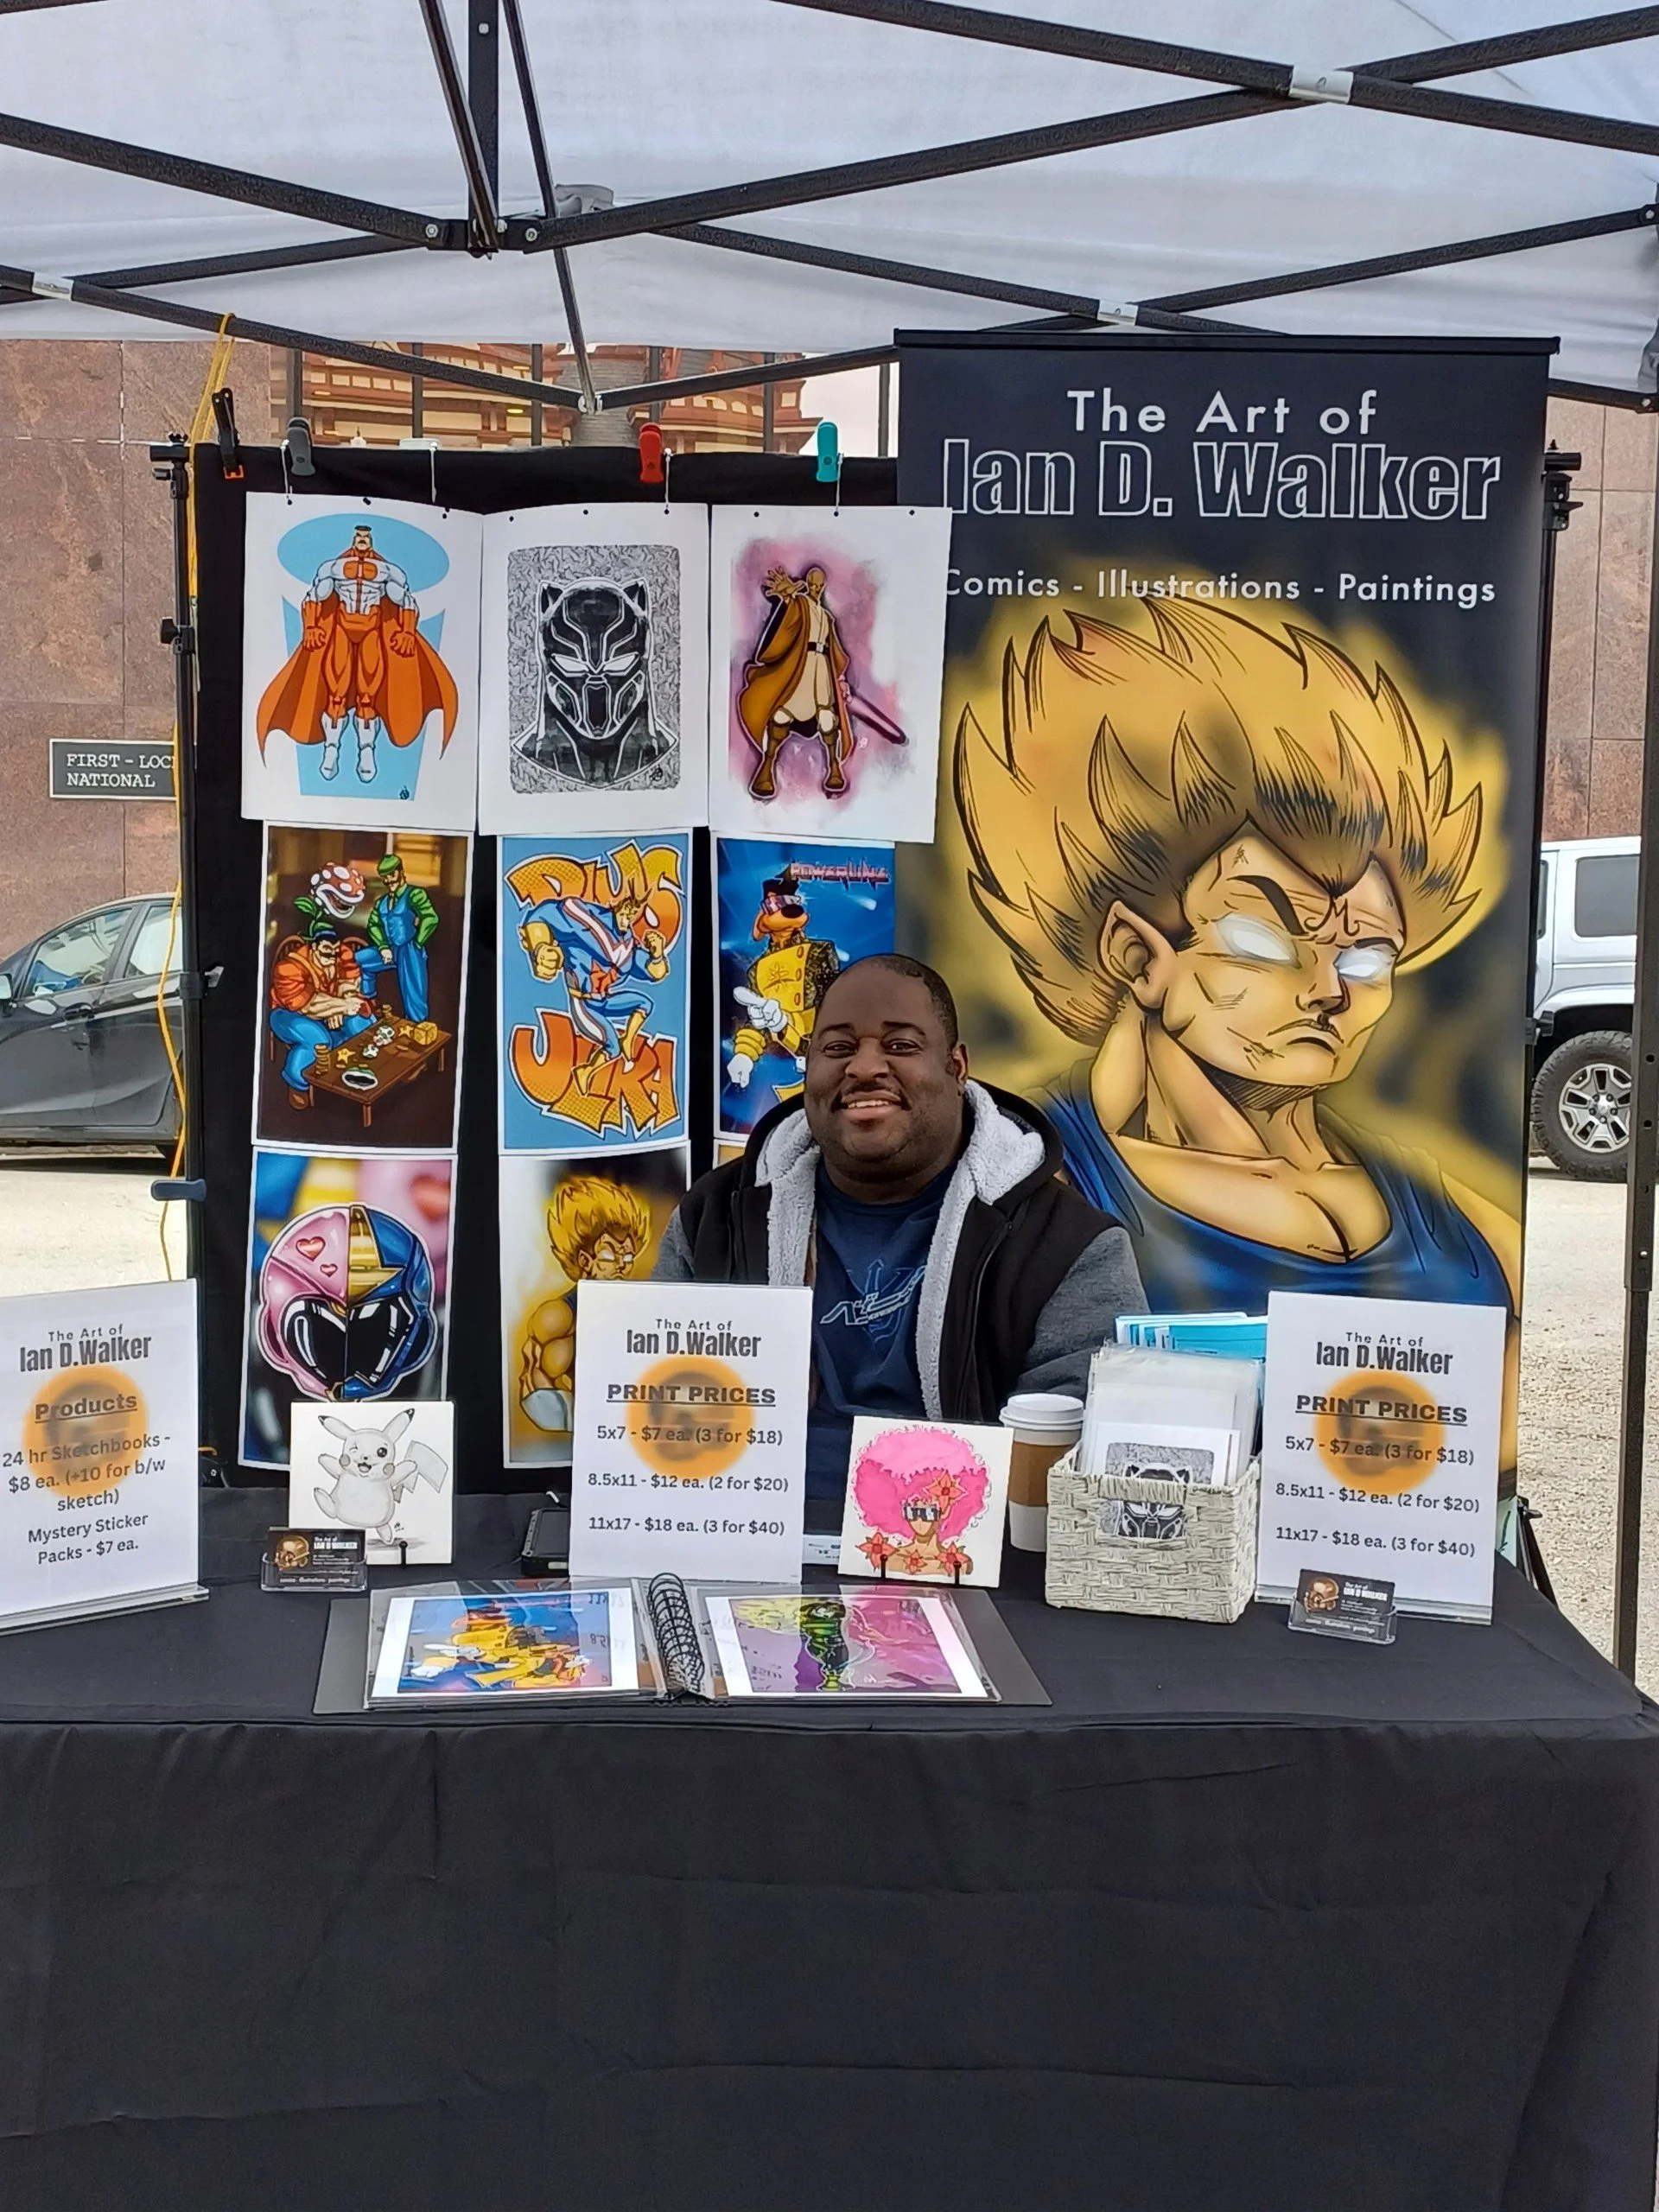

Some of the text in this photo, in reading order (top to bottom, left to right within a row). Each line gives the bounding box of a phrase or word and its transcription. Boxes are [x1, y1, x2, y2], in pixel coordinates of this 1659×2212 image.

[1067, 388, 1377, 435] The Art of
[944, 439, 1501, 520] Ian D. Walker
[946, 569, 1059, 597] Comics
[1098, 570, 1300, 601] Illustrations
[1339, 575, 1496, 609] Paintings
[67, 753, 120, 767] FIRST
[67, 773, 156, 787] NATIONAL
[48, 1325, 124, 1342] The Art of
[656, 1319, 732, 1331] The Art of
[626, 1330, 658, 1354] Ian
[1345, 1332, 1424, 1347] The Art of
[20, 1347, 52, 1371] Ian
[1317, 1342, 1349, 1368] Ian
[607, 1384, 776, 1403] PRINT PRICES
[35, 1393, 137, 1421] Products
[1297, 1395, 1467, 1422] PRINT PRICES
[597, 1427, 626, 1440] 5x7
[642, 1426, 661, 1441] $7
[665, 1430, 690, 1441] ea.
[696, 1428, 711, 1444] (3
[717, 1428, 741, 1443] for
[747, 1430, 782, 1445] $18)
[3, 1452, 23, 1467] 24
[29, 1448, 47, 1464] hr
[52, 1433, 160, 1460] Sketchbooks
[1286, 1436, 1314, 1452] 5x7
[1330, 1440, 1349, 1455] $7
[1354, 1446, 1379, 1458] ea.
[1385, 1444, 1401, 1460] (3
[1407, 1446, 1432, 1461] for
[1437, 1448, 1474, 1465] $18)
[9, 1458, 165, 1494] $8 ea. (+10 for b/w
[588, 1473, 637, 1487] 8.5x11
[651, 1475, 677, 1489] $12
[683, 1478, 704, 1489] ea.
[709, 1477, 722, 1491] (2
[728, 1476, 750, 1490] for
[753, 1478, 789, 1492] $20)
[58, 1488, 119, 1512] sketch)
[1275, 1483, 1325, 1499] 8.5x11
[1339, 1487, 1365, 1503] $12
[1370, 1494, 1393, 1505] ea.
[1397, 1493, 1412, 1509] (2
[1417, 1494, 1440, 1510] for
[1444, 1497, 1479, 1513] $20)
[28, 1513, 148, 1544] Mystery Sticker
[588, 1517, 632, 1530] 11x17
[645, 1518, 671, 1532] $18
[677, 1522, 698, 1532] ea.
[703, 1520, 717, 1534] (3
[722, 1520, 744, 1534] for
[749, 1521, 785, 1535] $40)
[38, 1548, 83, 1564] Packs
[97, 1541, 112, 1556] $7
[117, 1539, 138, 1552] ea.
[1276, 1527, 1318, 1542] 11x17
[1332, 1531, 1360, 1547] $18
[1364, 1537, 1387, 1548] ea.
[1392, 1536, 1407, 1552] (3
[1411, 1537, 1433, 1553] for
[1438, 1541, 1475, 1558] $40)
